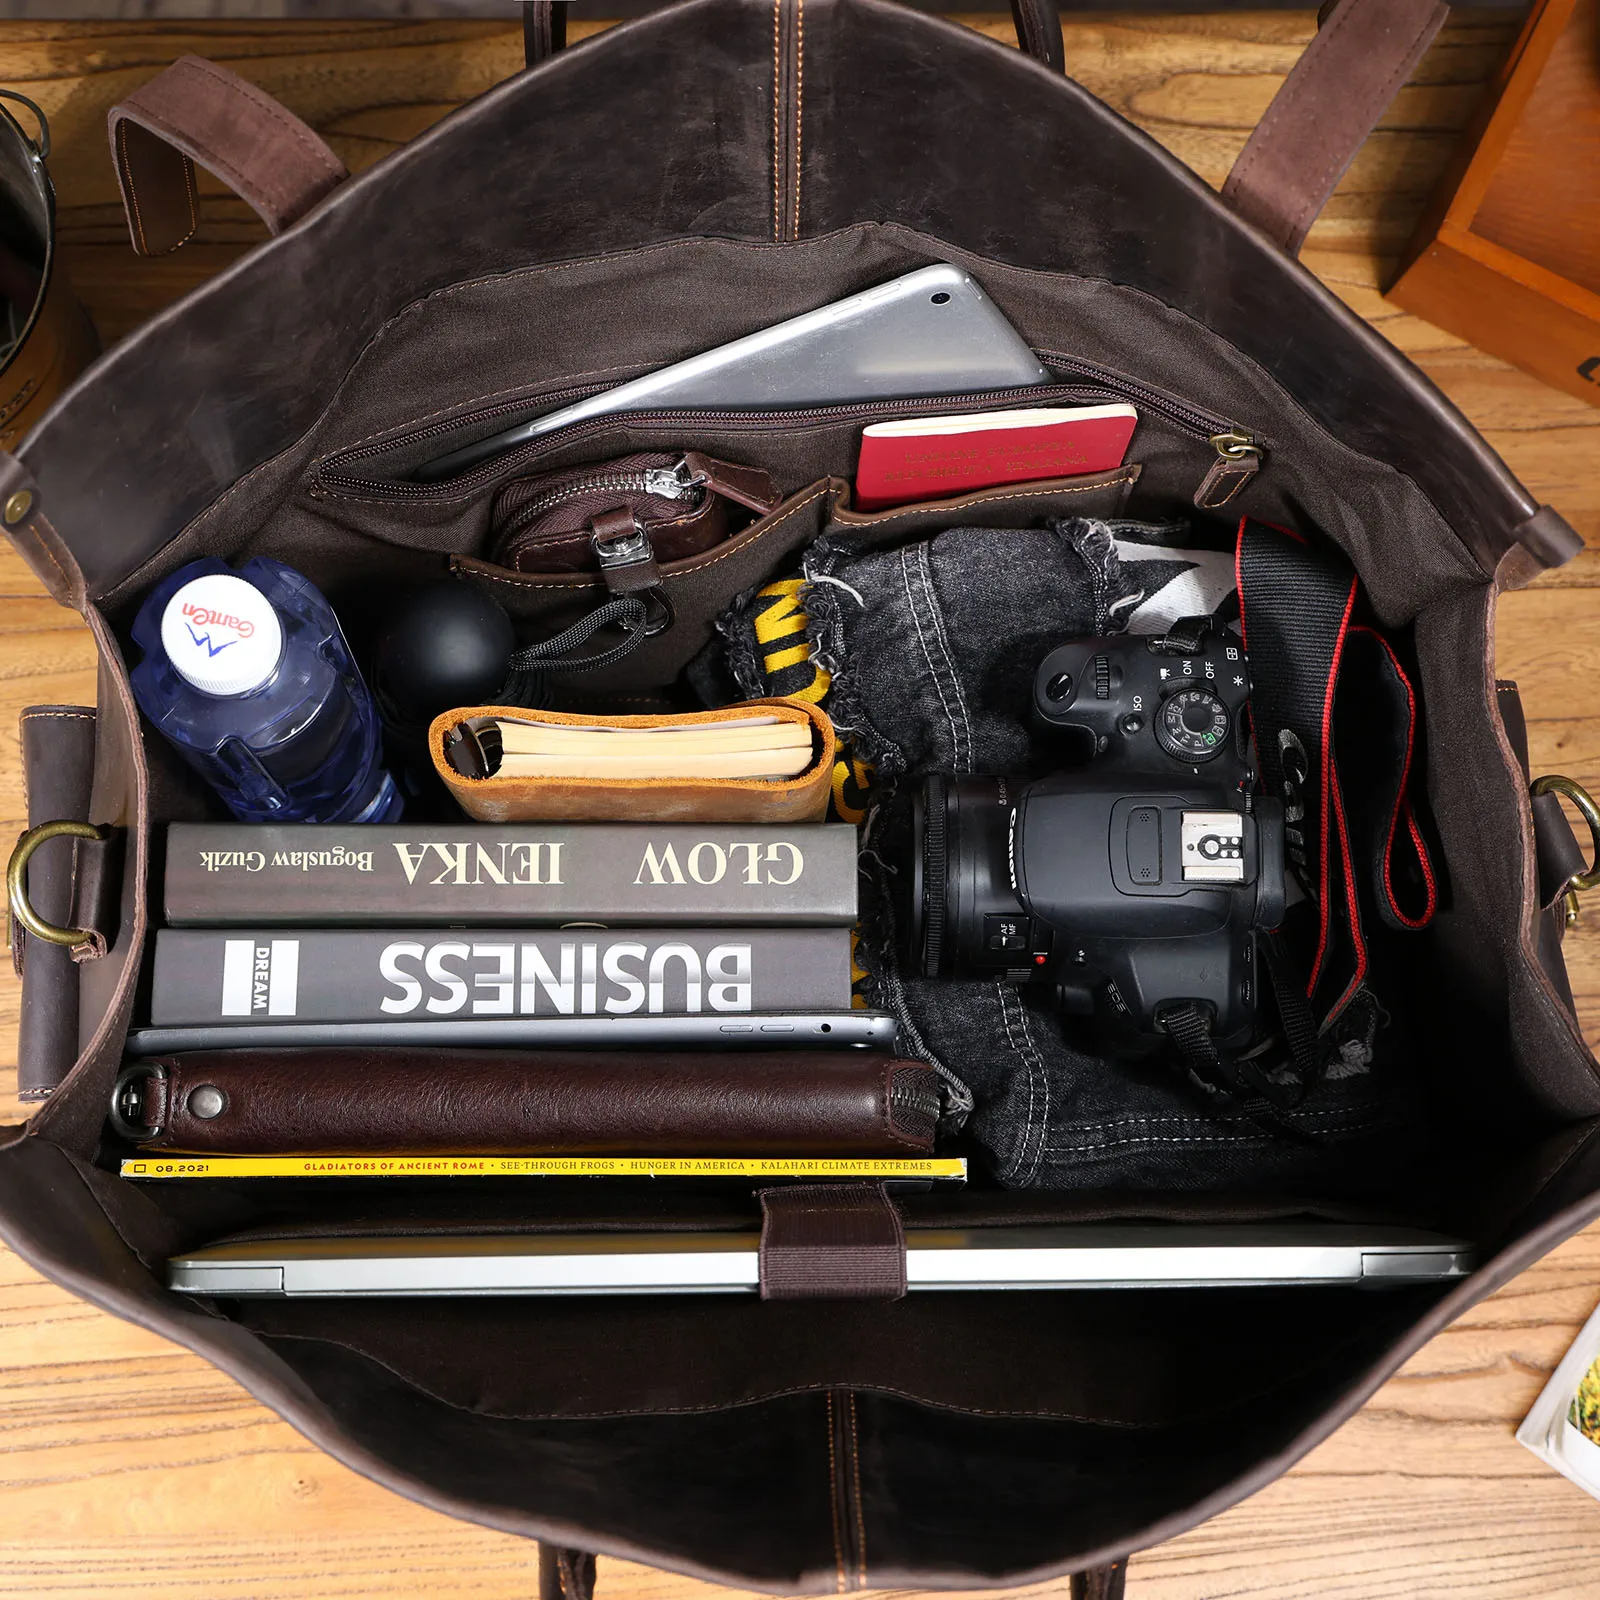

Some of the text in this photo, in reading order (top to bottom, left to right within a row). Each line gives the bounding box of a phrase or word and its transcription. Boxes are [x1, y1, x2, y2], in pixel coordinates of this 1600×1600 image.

[1182, 660, 1193, 675] ON
[1205, 660, 1215, 679] OFF
[1133, 695, 1142, 711] ISO
[1167, 715, 1176, 723] M
[1008, 807, 1018, 890] Canon
[199, 851, 265, 872] Guzik
[392, 842, 565, 885] IENKA
[1000, 923, 1008, 935] AF
[1008, 923, 1017, 935] MF
[253, 946, 270, 1010] DREAM
[379, 941, 752, 1015] BUSINESS
[155, 1164, 209, 1172] 08.2021
[304, 1161, 932, 1171] GLADIATORS OF ANCIENT ROME SEE-THROUGH FROGS HUNGER IN AMERICA KALAHARI CLIMATE EXTREMES
